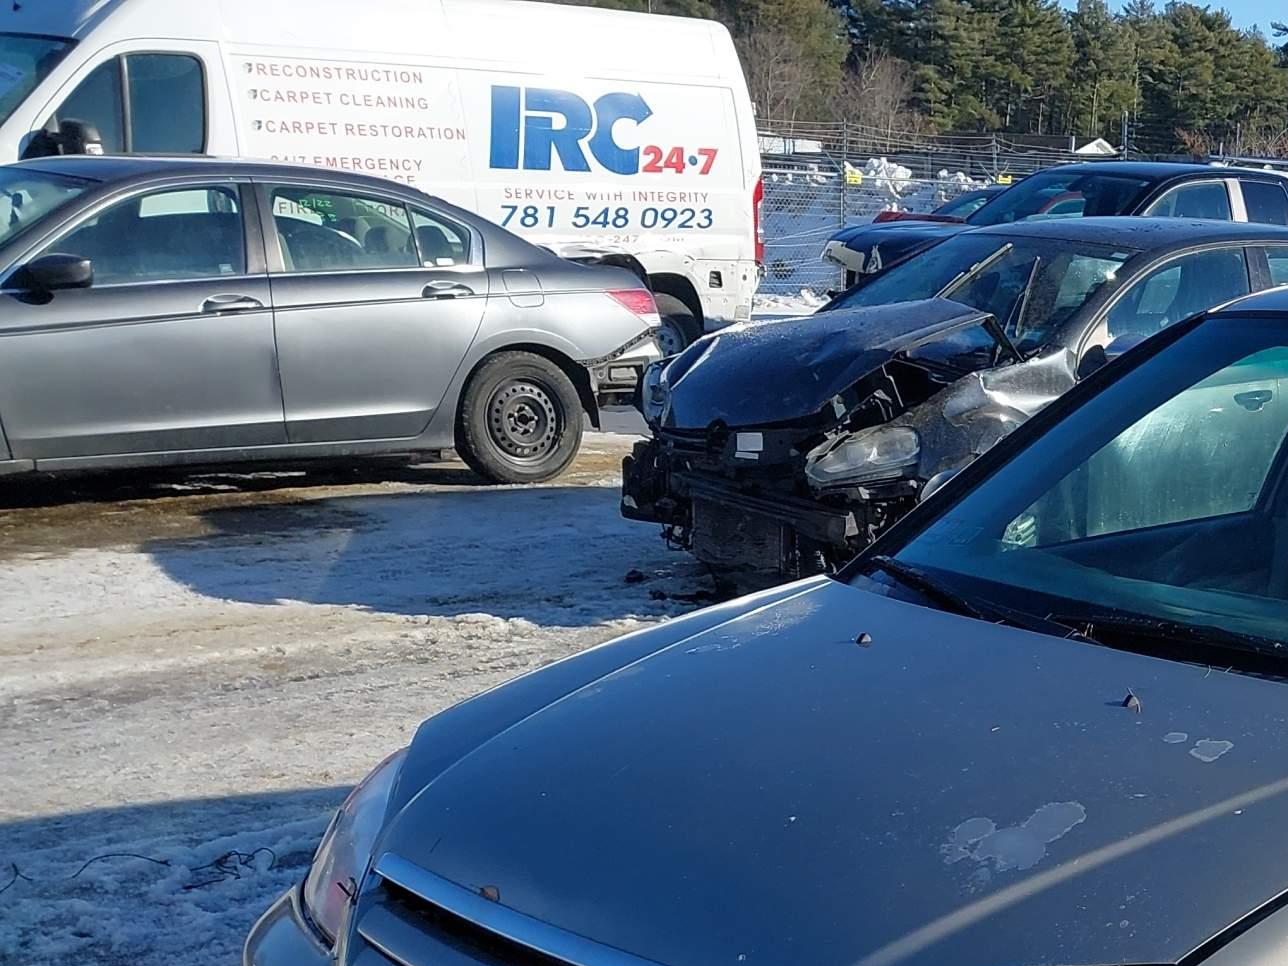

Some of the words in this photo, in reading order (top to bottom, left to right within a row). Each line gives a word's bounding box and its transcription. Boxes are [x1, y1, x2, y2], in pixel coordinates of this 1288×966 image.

[256, 63, 424, 84] RECONSTRUCTION
[260, 89, 333, 105] CARPET
[339, 94, 429, 110] CLEANING
[265, 120, 338, 135] CARPET
[345, 123, 466, 141] RESTORATION
[489, 84, 654, 176] IRC
[313, 156, 423, 171] EMERGENCY
[504, 187, 575, 201] SERVICE
[632, 191, 709, 203] INTEGRITY
[500, 205, 556, 228] 781
[571, 206, 630, 229] 548
[640, 207, 714, 229] 0923
